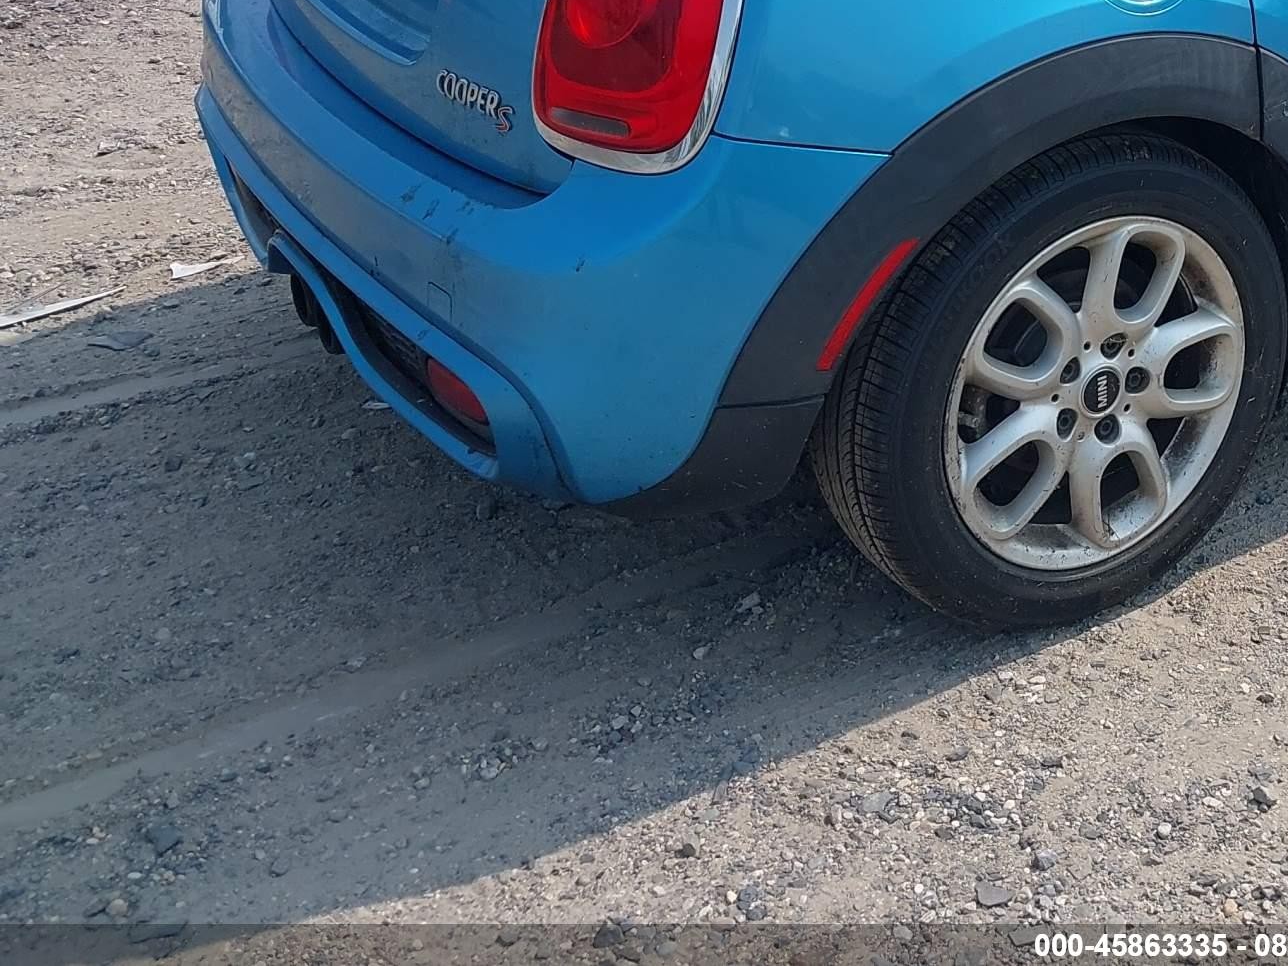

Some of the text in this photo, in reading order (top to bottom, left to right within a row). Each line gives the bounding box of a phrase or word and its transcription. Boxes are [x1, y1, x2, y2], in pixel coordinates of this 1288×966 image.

[436, 69, 513, 132] COOPER S
[1097, 375, 1108, 409] MINI
